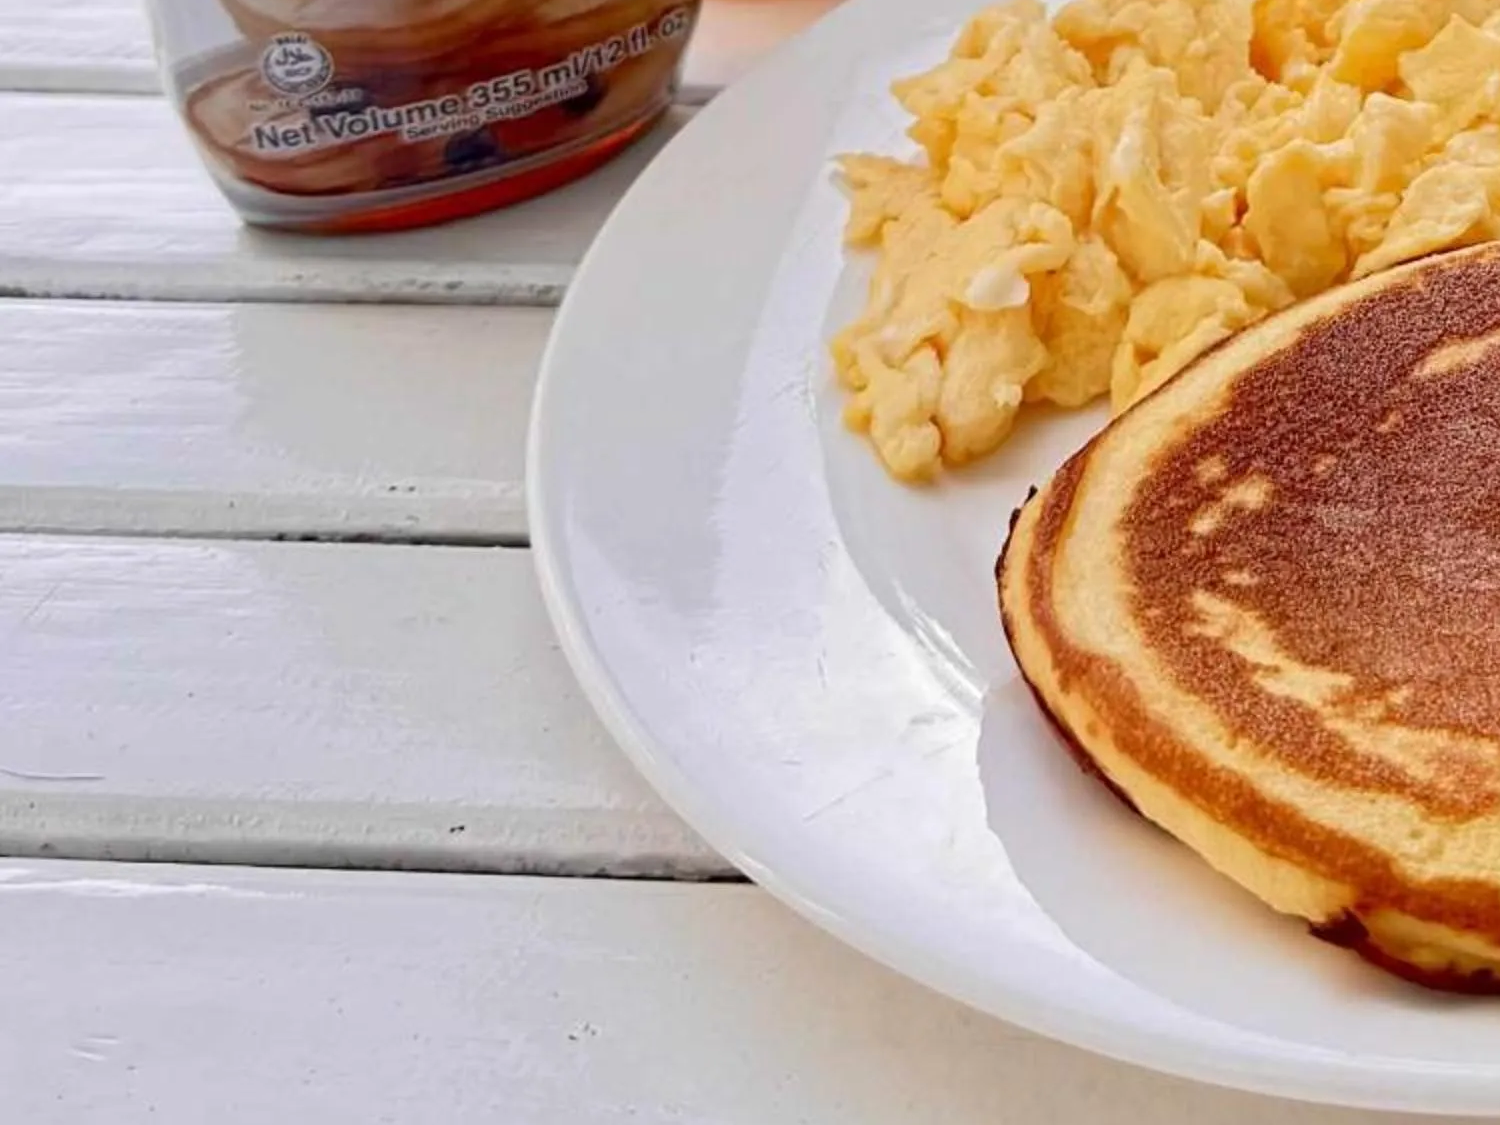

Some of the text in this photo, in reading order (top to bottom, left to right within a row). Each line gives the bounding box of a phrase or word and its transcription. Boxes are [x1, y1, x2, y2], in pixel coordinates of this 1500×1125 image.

[254, 123, 316, 150] Net
[322, 95, 460, 140] Volume
[471, 75, 532, 109] 355
[404, 110, 479, 141] Serving
